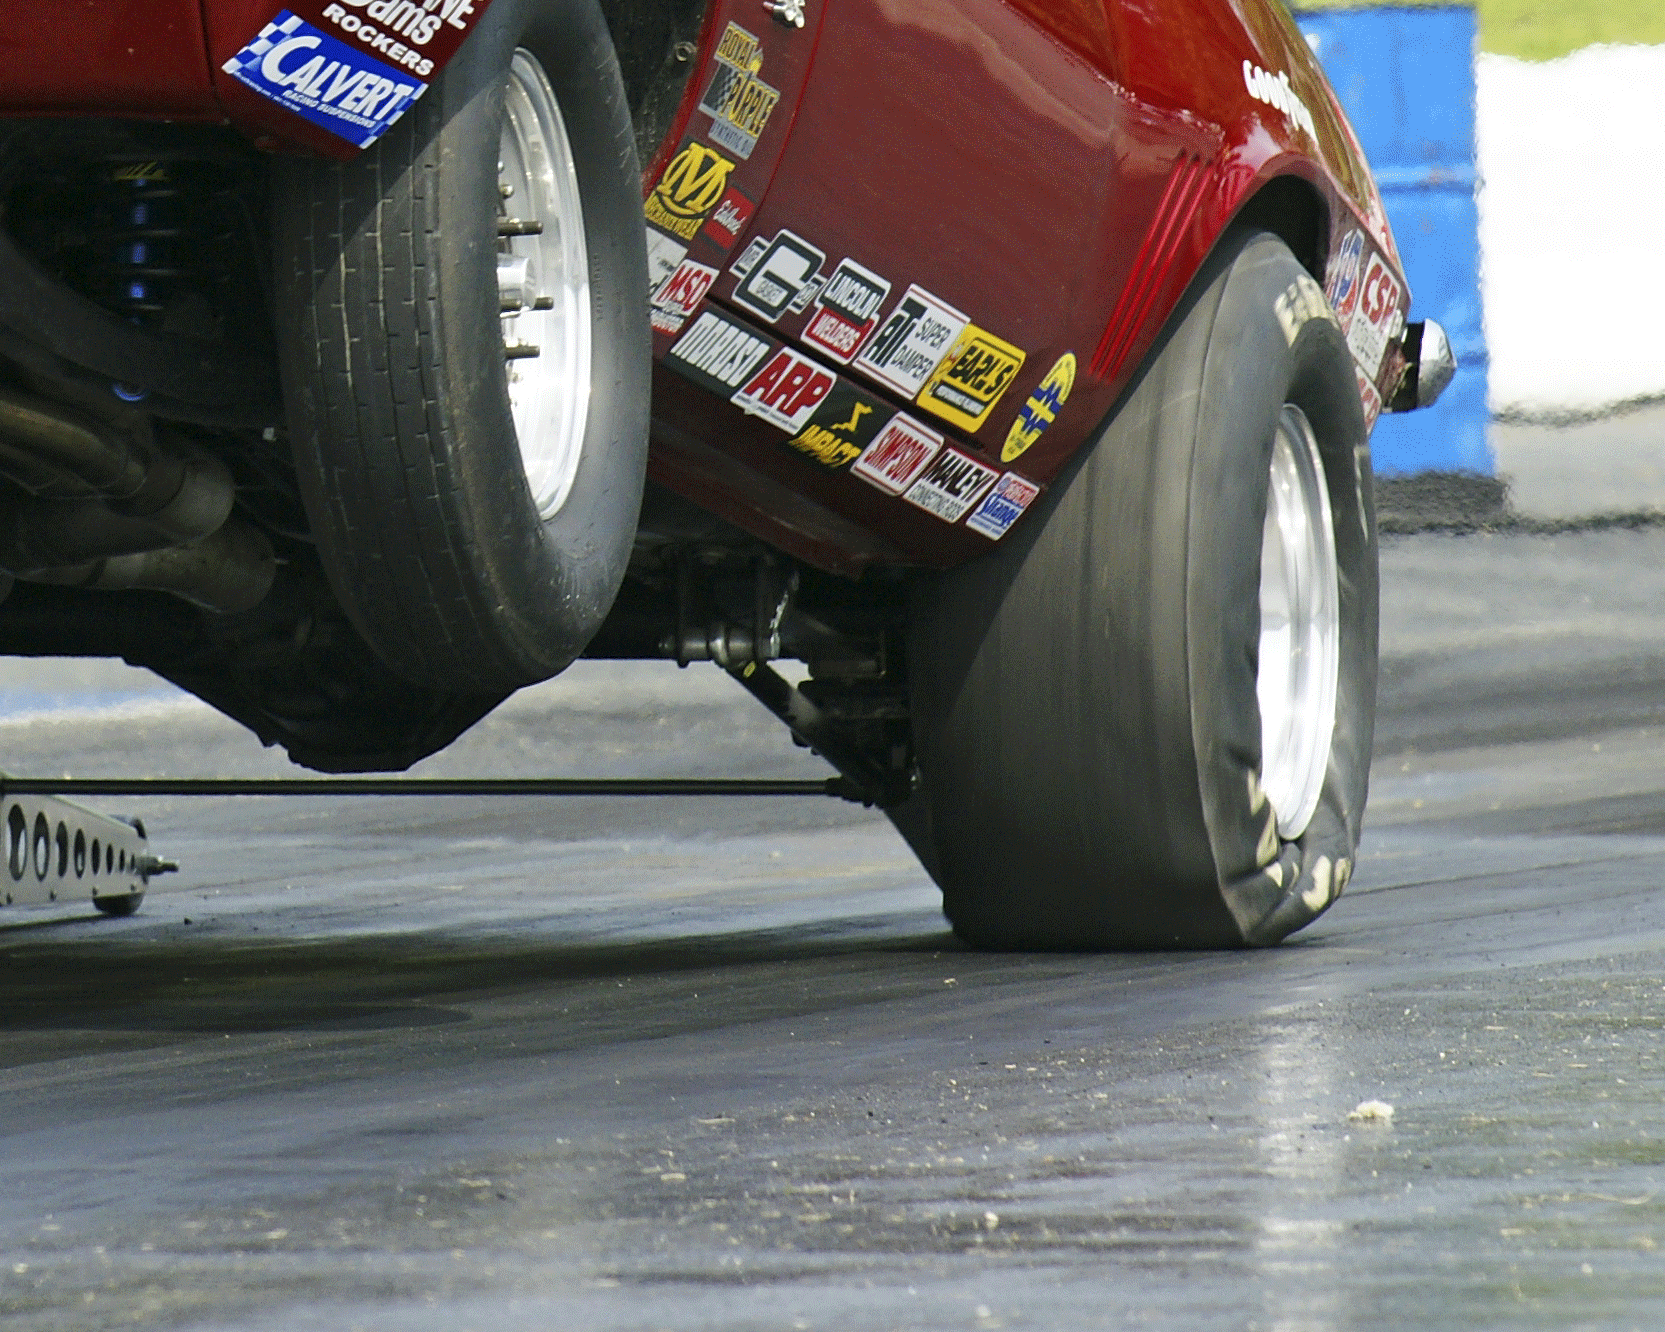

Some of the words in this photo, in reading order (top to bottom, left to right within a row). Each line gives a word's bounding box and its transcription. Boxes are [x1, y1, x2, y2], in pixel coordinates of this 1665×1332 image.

[322, 3, 435, 76] ROCKERS
[261, 35, 414, 120] CALVERT
[656, 265, 711, 311] MSD
[825, 272, 881, 319] LINCOLN
[670, 312, 770, 387] MOROSO
[812, 313, 861, 353] WELDERS
[915, 317, 951, 350] SUPER
[743, 352, 833, 418] ARP
[891, 344, 934, 381] DAMPER
[864, 426, 932, 485] SIMPSON
[922, 452, 995, 502] MANLEY
